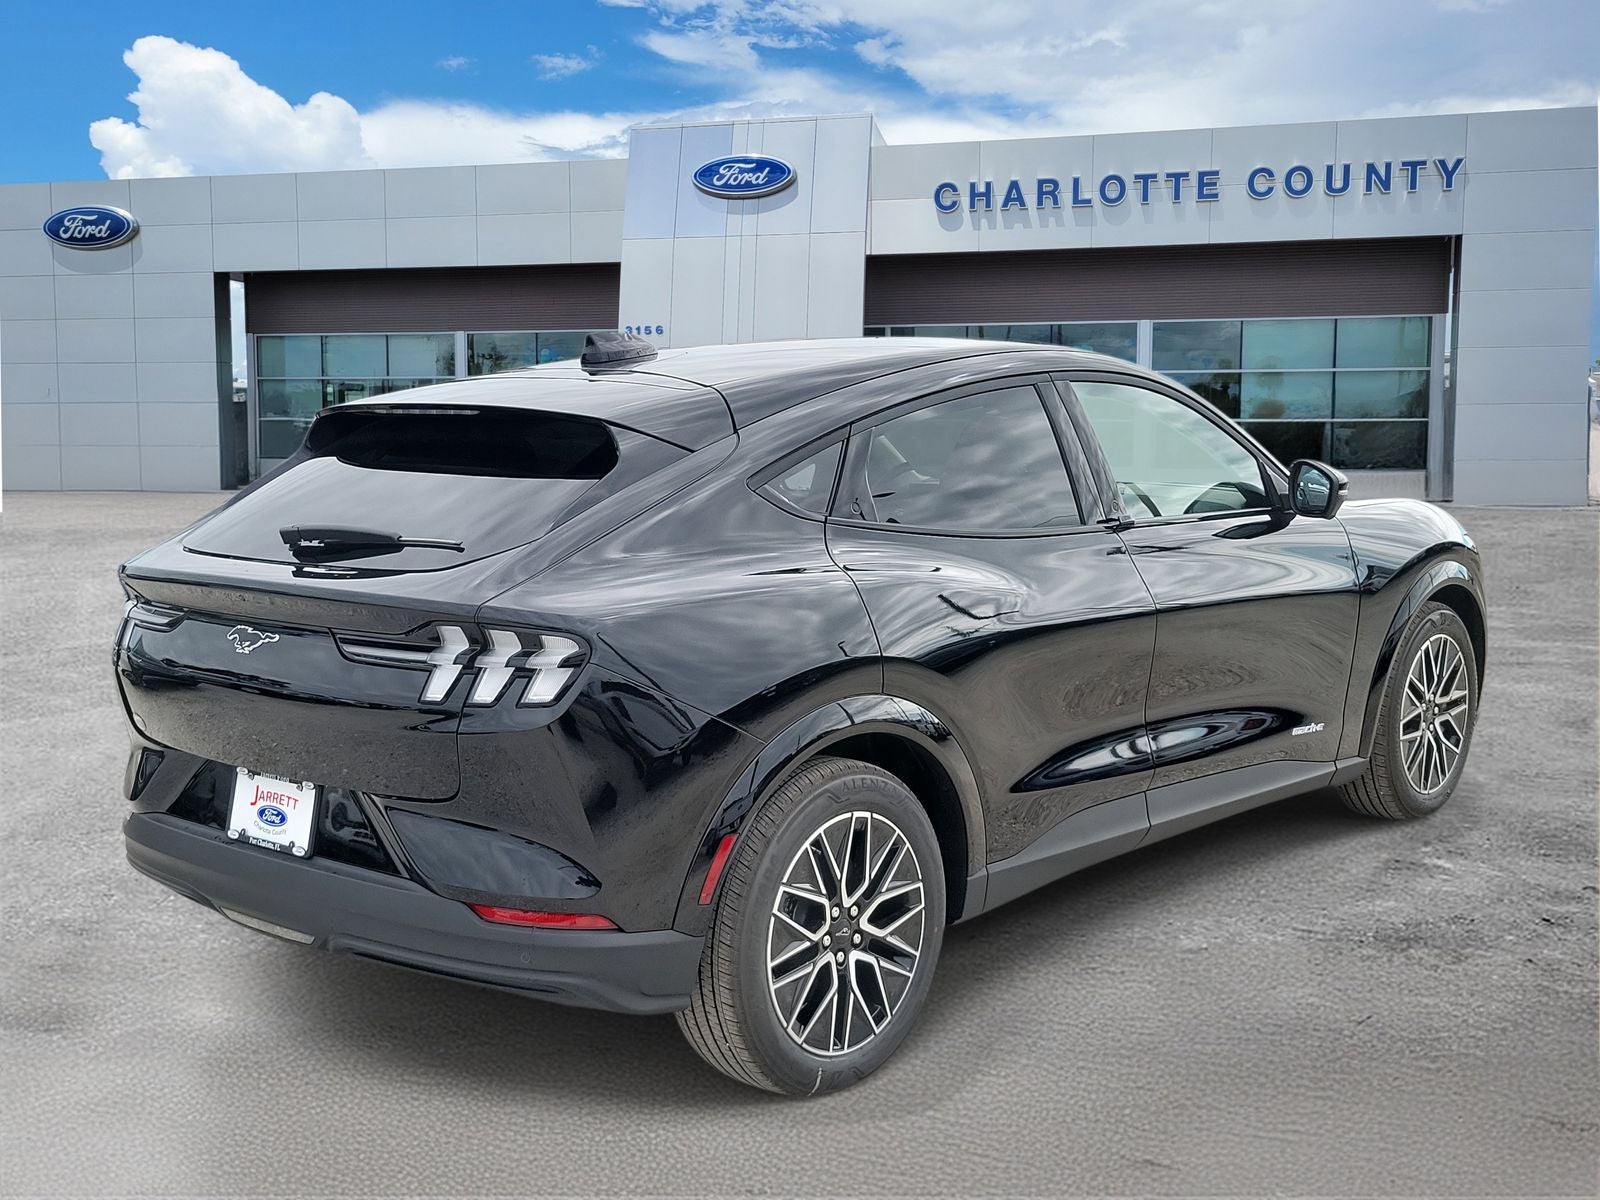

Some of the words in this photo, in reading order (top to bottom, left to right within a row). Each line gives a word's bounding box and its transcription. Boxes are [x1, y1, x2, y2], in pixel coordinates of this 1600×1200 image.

[712, 163, 768, 186] Ford
[934, 169, 1222, 214] CHARLOTTE
[1246, 157, 1466, 200] COUNTY
[59, 214, 111, 239] Ford
[625, 325, 664, 336] 3156
[262, 808, 282, 824] Ford
